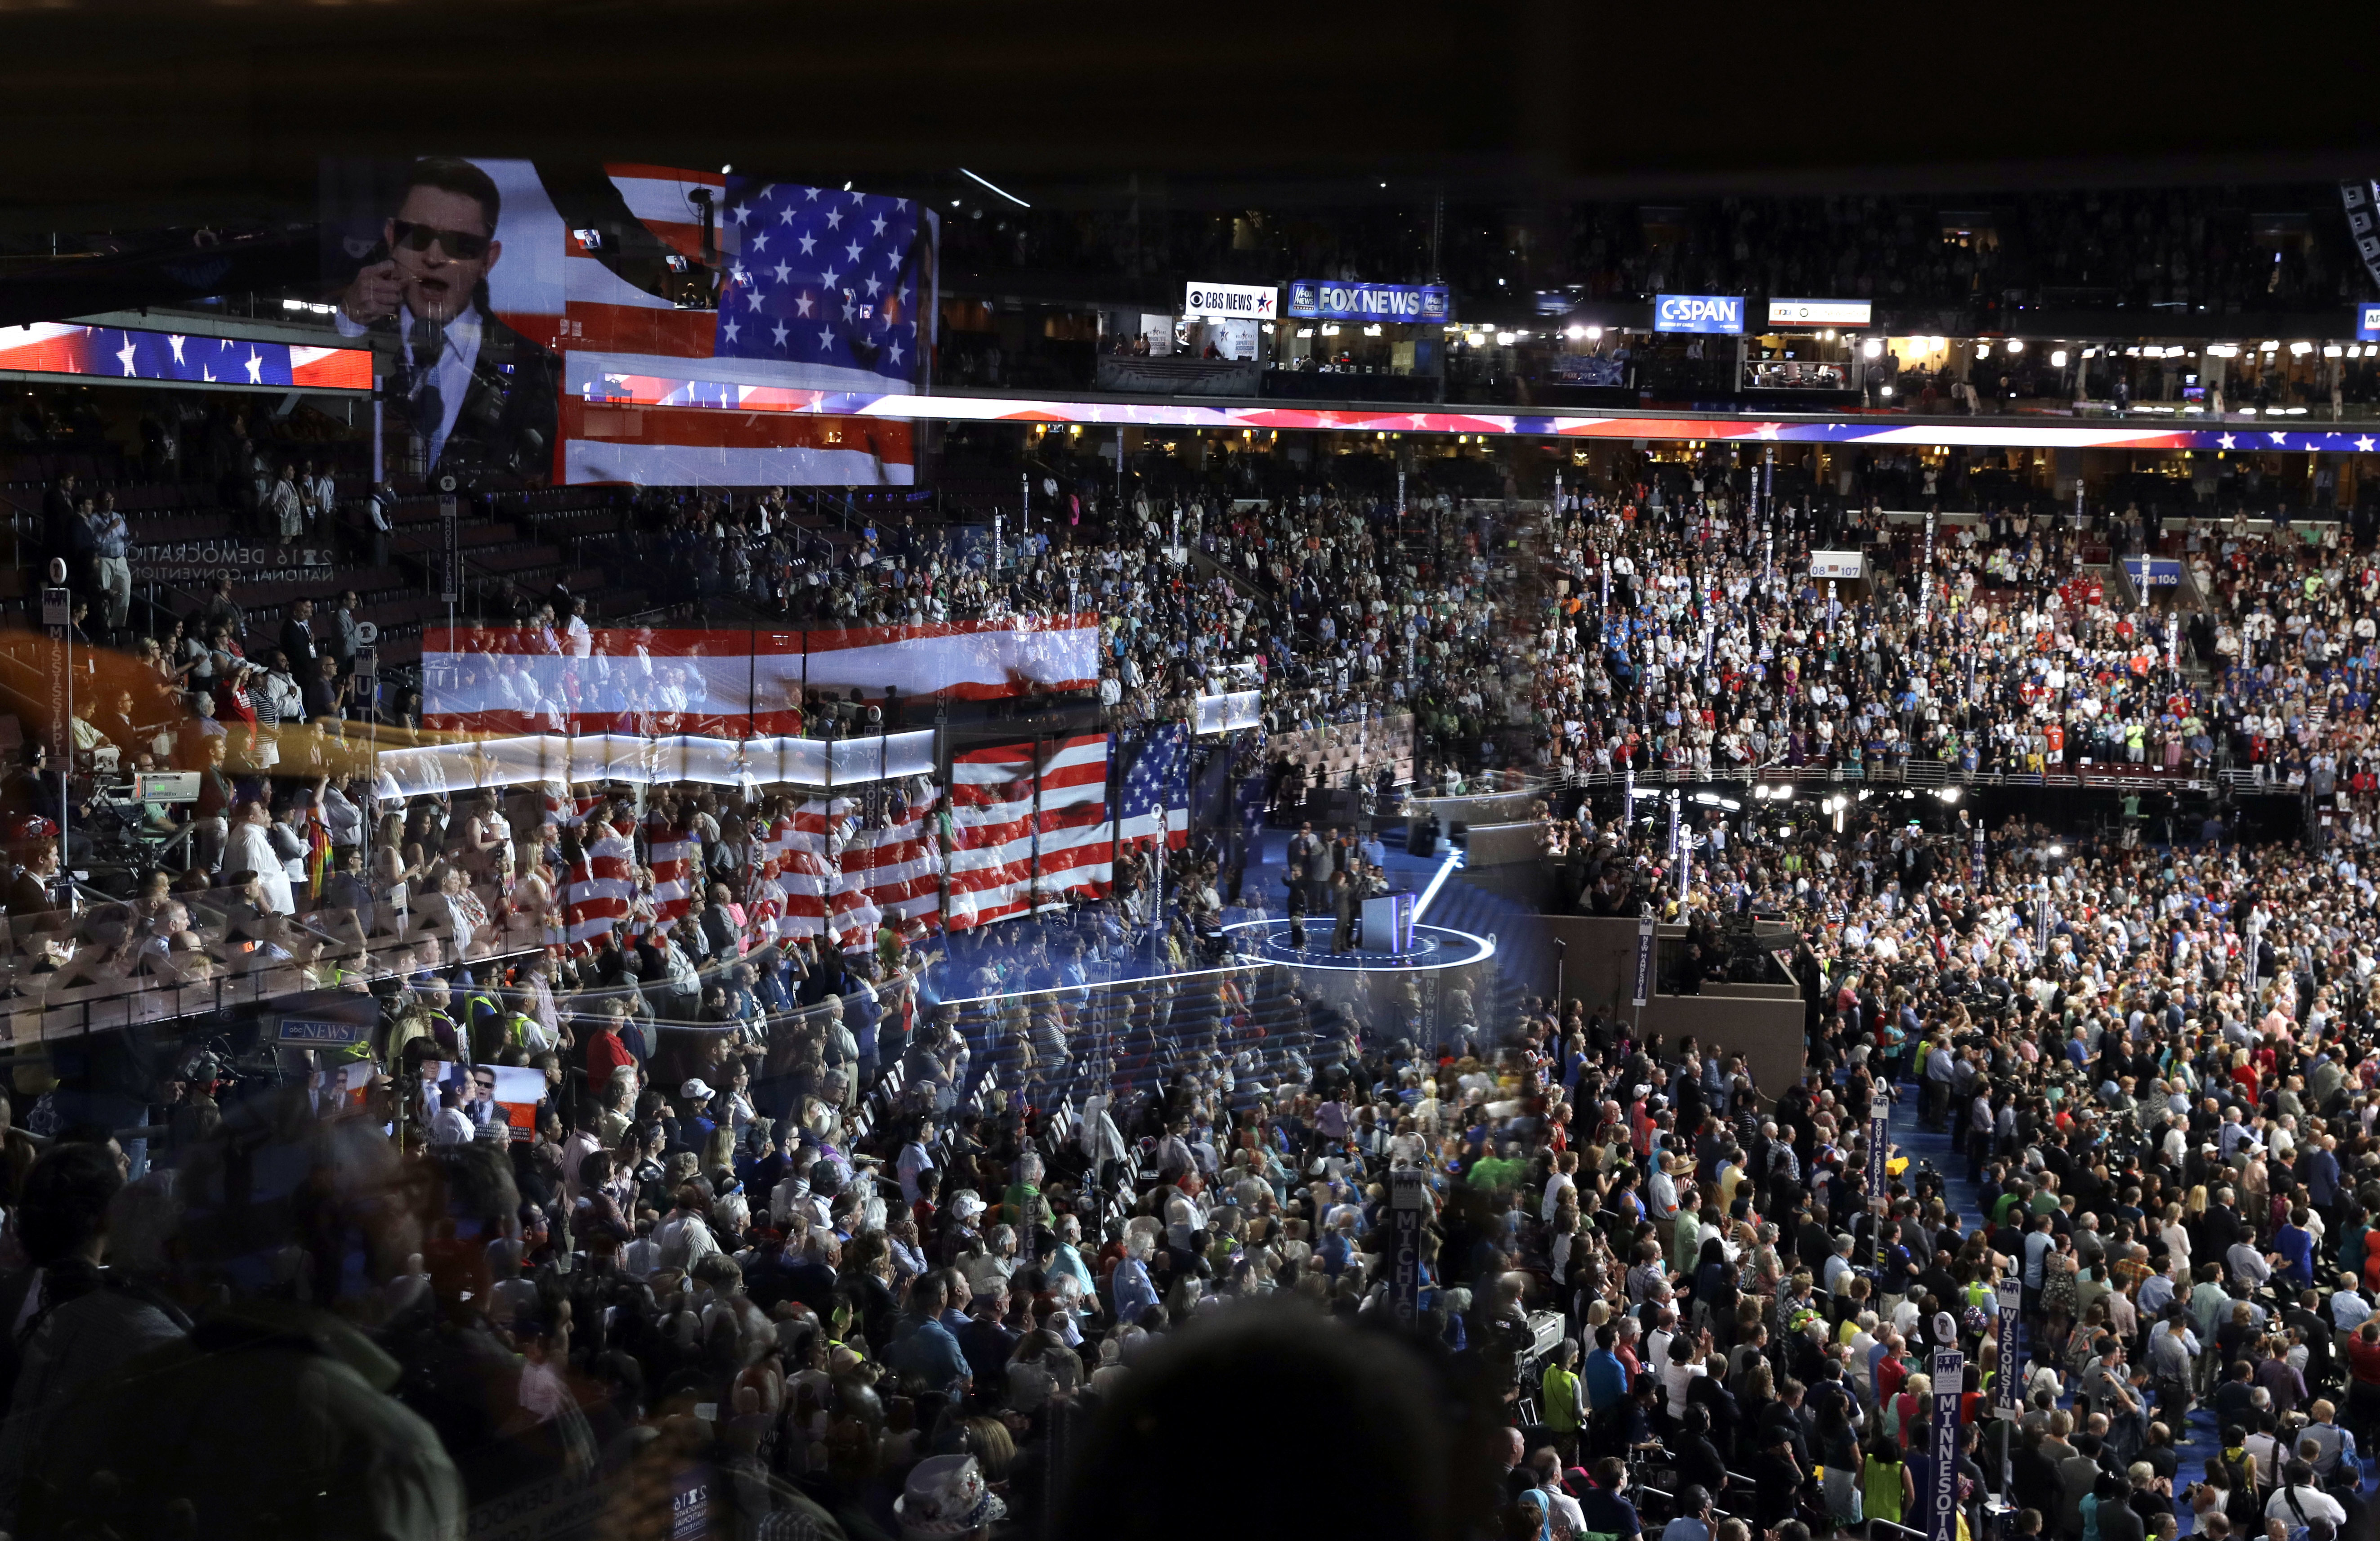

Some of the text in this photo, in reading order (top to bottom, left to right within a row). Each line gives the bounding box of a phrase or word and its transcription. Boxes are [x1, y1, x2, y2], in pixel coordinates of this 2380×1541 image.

[1206, 292, 1252, 311] CBS NEWS
[1319, 287, 1419, 315] FOX NEWS
[1661, 300, 1736, 322] C-SPAN
[1812, 566, 1858, 576] 08 107
[2158, 574, 2178, 584] 106
[1919, 588, 1928, 620] IDAHO
[50, 626, 63, 756] MISSISSIPPI
[355, 677, 372, 782] UTAH
[1637, 953, 1646, 999] HAMPSHIRE
[302, 1023, 349, 1039] NEWS
[1090, 991, 1106, 1096] INDIANA
[1424, 979, 1436, 1059] NEW MEXICO
[1484, 975, 1494, 1052] HAWAII
[1026, 1196, 1035, 1261] ORIDA
[1396, 1212, 1416, 1320] MICHIG
[2000, 1308, 2017, 1408] WISCONSIN
[1935, 1395, 1956, 1541] MINNESOTA
